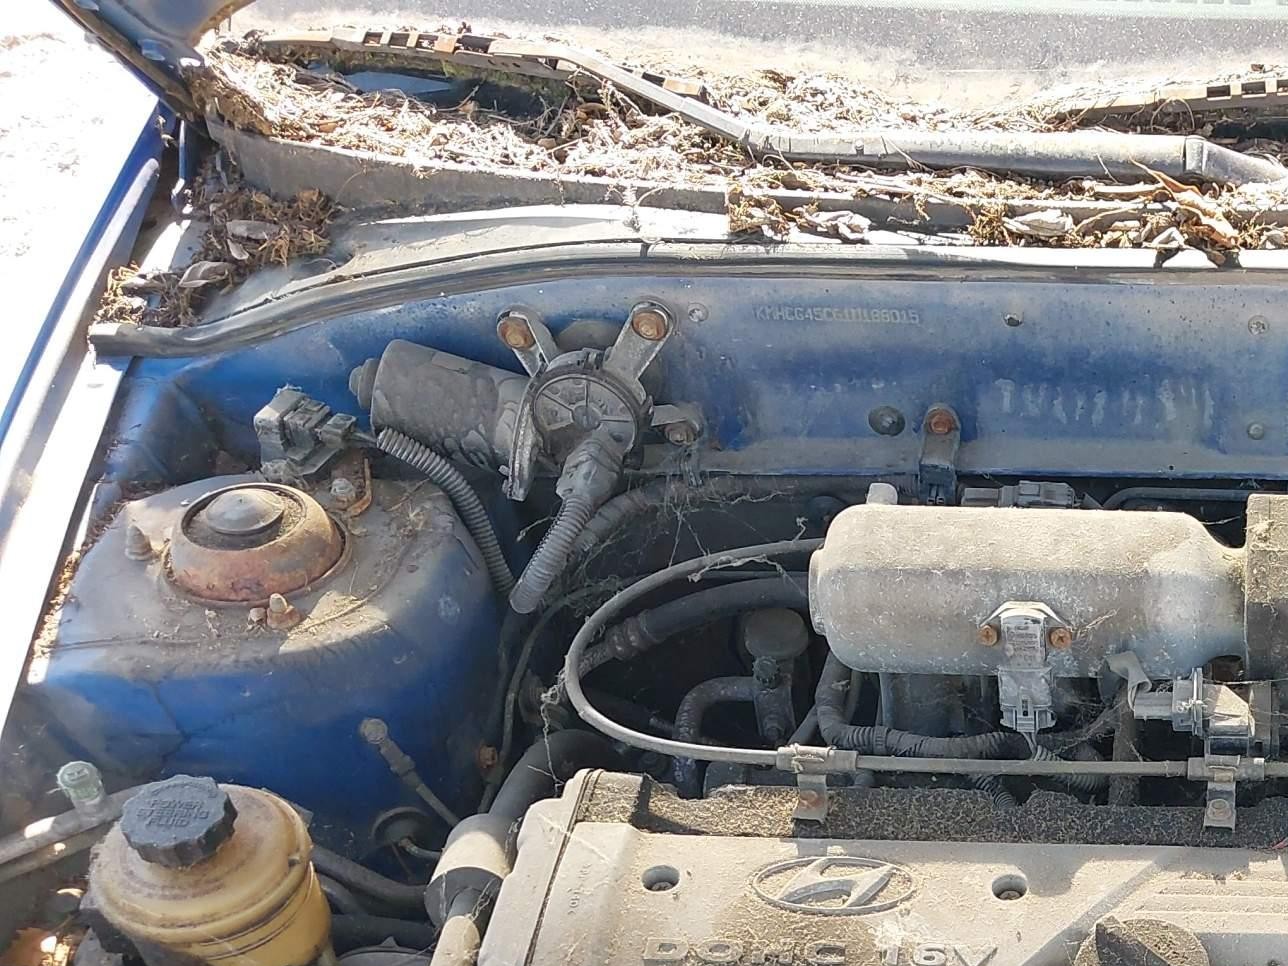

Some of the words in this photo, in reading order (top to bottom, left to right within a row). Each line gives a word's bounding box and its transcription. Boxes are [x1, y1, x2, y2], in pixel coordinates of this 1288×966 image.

[150, 799, 205, 809] POWER
[136, 807, 210, 820] STEERING
[145, 817, 189, 828] FLUID
